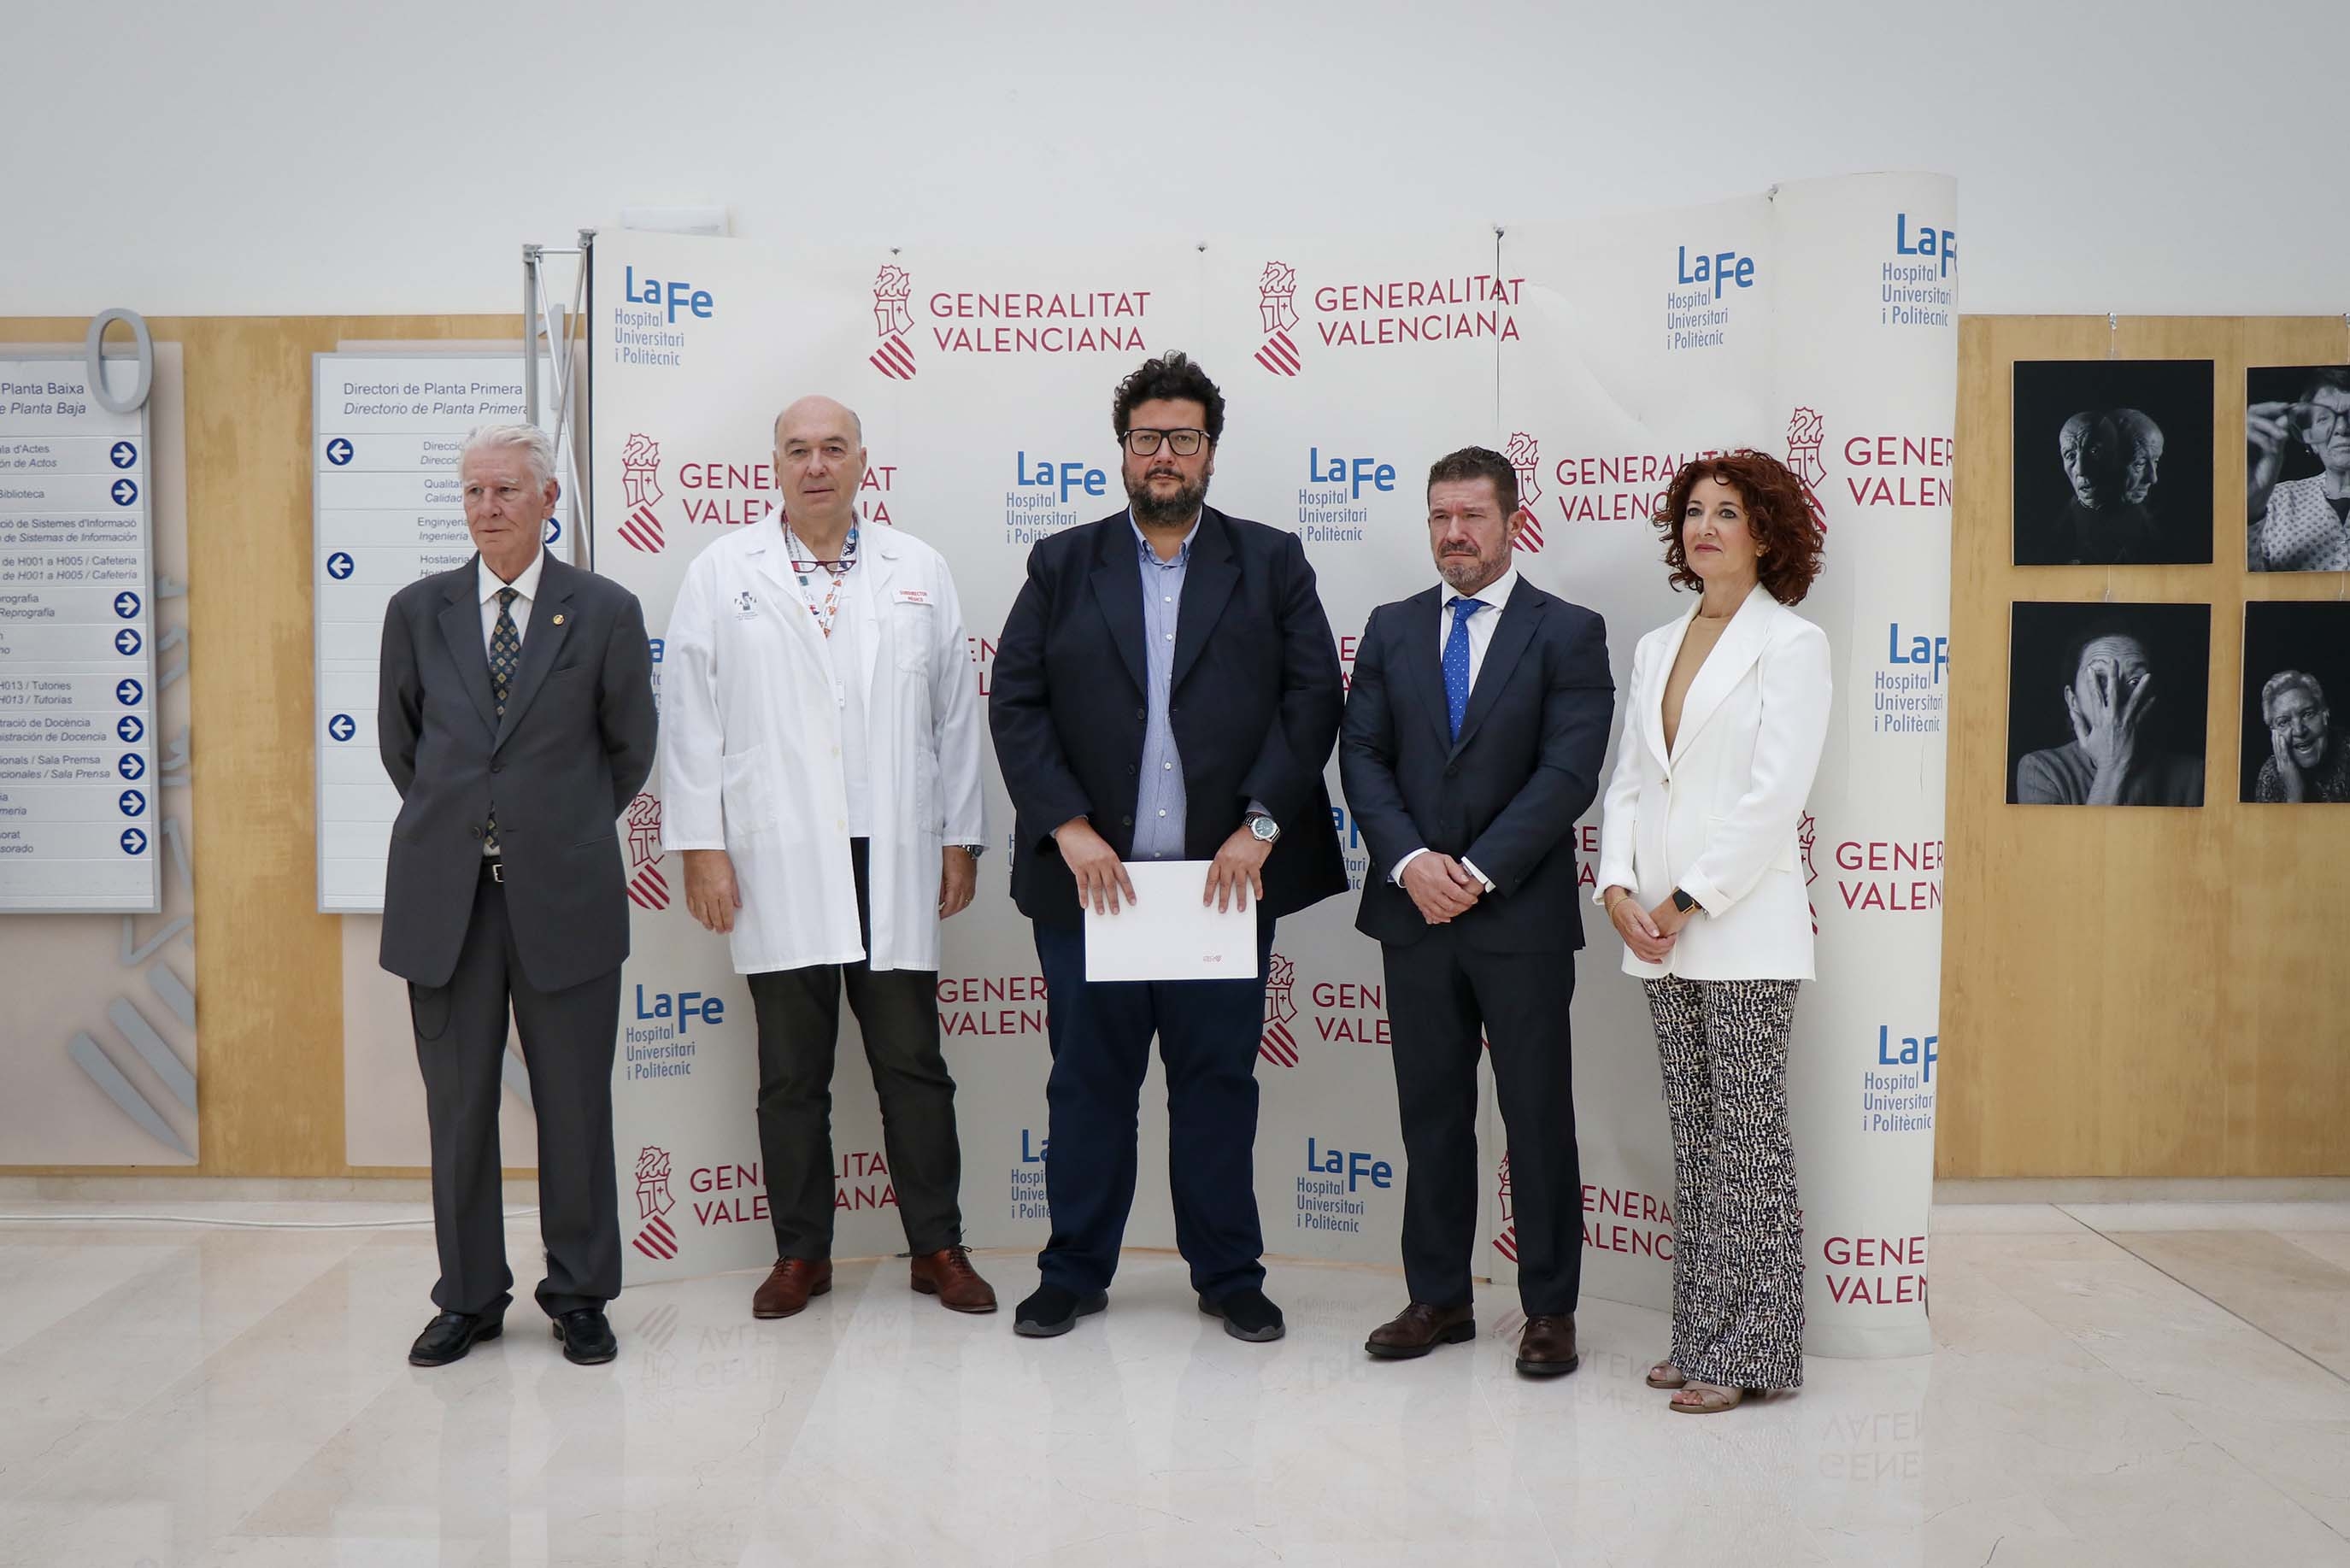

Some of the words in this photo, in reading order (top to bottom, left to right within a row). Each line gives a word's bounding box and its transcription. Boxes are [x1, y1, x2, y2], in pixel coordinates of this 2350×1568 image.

[1883, 262, 1937, 285] Hospital
[1314, 275, 1525, 312] GENERALITAT
[1668, 287, 1710, 311] Hospital
[1883, 284, 1952, 306] Universitari
[930, 292, 1151, 318] GENERALITAT
[614, 308, 663, 330] Hospital
[1667, 308, 1728, 330] Universitari
[1883, 308, 1886, 325] i
[1893, 305, 1948, 326] Politècnic
[614, 327, 684, 348] Universitari
[1318, 310, 1519, 347] VALENCIANA
[932, 326, 1146, 352] VALENCIANA
[1675, 331, 1724, 349] Politècnic
[623, 348, 681, 366] Politècnic
[2, 382, 43, 394] Planta
[48, 382, 84, 394] Baixa
[344, 383, 399, 395] Directori
[403, 383, 420, 395] de
[425, 383, 466, 395] Planta
[471, 383, 522, 395] Primera
[10, 402, 52, 414] Planta
[56, 402, 85, 416] Baja
[344, 402, 408, 414] Directorio
[412, 402, 428, 414] de
[432, 402, 474, 414] Planta
[14, 459, 26, 467] de
[28, 458, 57, 467] Actos
[1007, 491, 1055, 511] Hospital
[1299, 489, 1348, 508] Hospital
[16, 519, 28, 528] de
[32, 519, 75, 528] Sistemes
[1007, 510, 1077, 526] Universitari
[1299, 508, 1367, 524] Universitari
[4, 534, 16, 543] de
[20, 533, 63, 543] Sistemas
[66, 533, 79, 542] de
[1307, 526, 1362, 542] Politècnic
[3, 557, 15, 567] de
[18, 556, 43, 566] H001
[56, 556, 83, 566] H005
[3, 572, 15, 580] de
[18, 571, 44, 580] H001
[56, 571, 83, 579] H005
[1875, 671, 1930, 694] Hospital
[1875, 692, 1942, 711] Universitari
[29, 718, 42, 727] de
[1875, 715, 1878, 732] i
[1884, 714, 1940, 732] Politècnic
[45, 732, 57, 742] de
[61, 731, 107, 742] Docencia
[38, 755, 60, 765] Sala
[62, 755, 101, 764] Premsa
[50, 769, 73, 778] Sala
[75, 769, 110, 778] Prensa
[626, 1024, 674, 1044] Hospital
[626, 1041, 696, 1062] Universitari
[635, 1060, 691, 1080] Politècnic
[1865, 1071, 1918, 1094] Hospital
[1864, 1115, 1867, 1131] i
[1873, 1113, 1931, 1131] Politècnic
[1297, 1177, 1344, 1196] Hospital
[1297, 1195, 1364, 1215] Universitari
[1305, 1213, 1360, 1232] Politècnic
